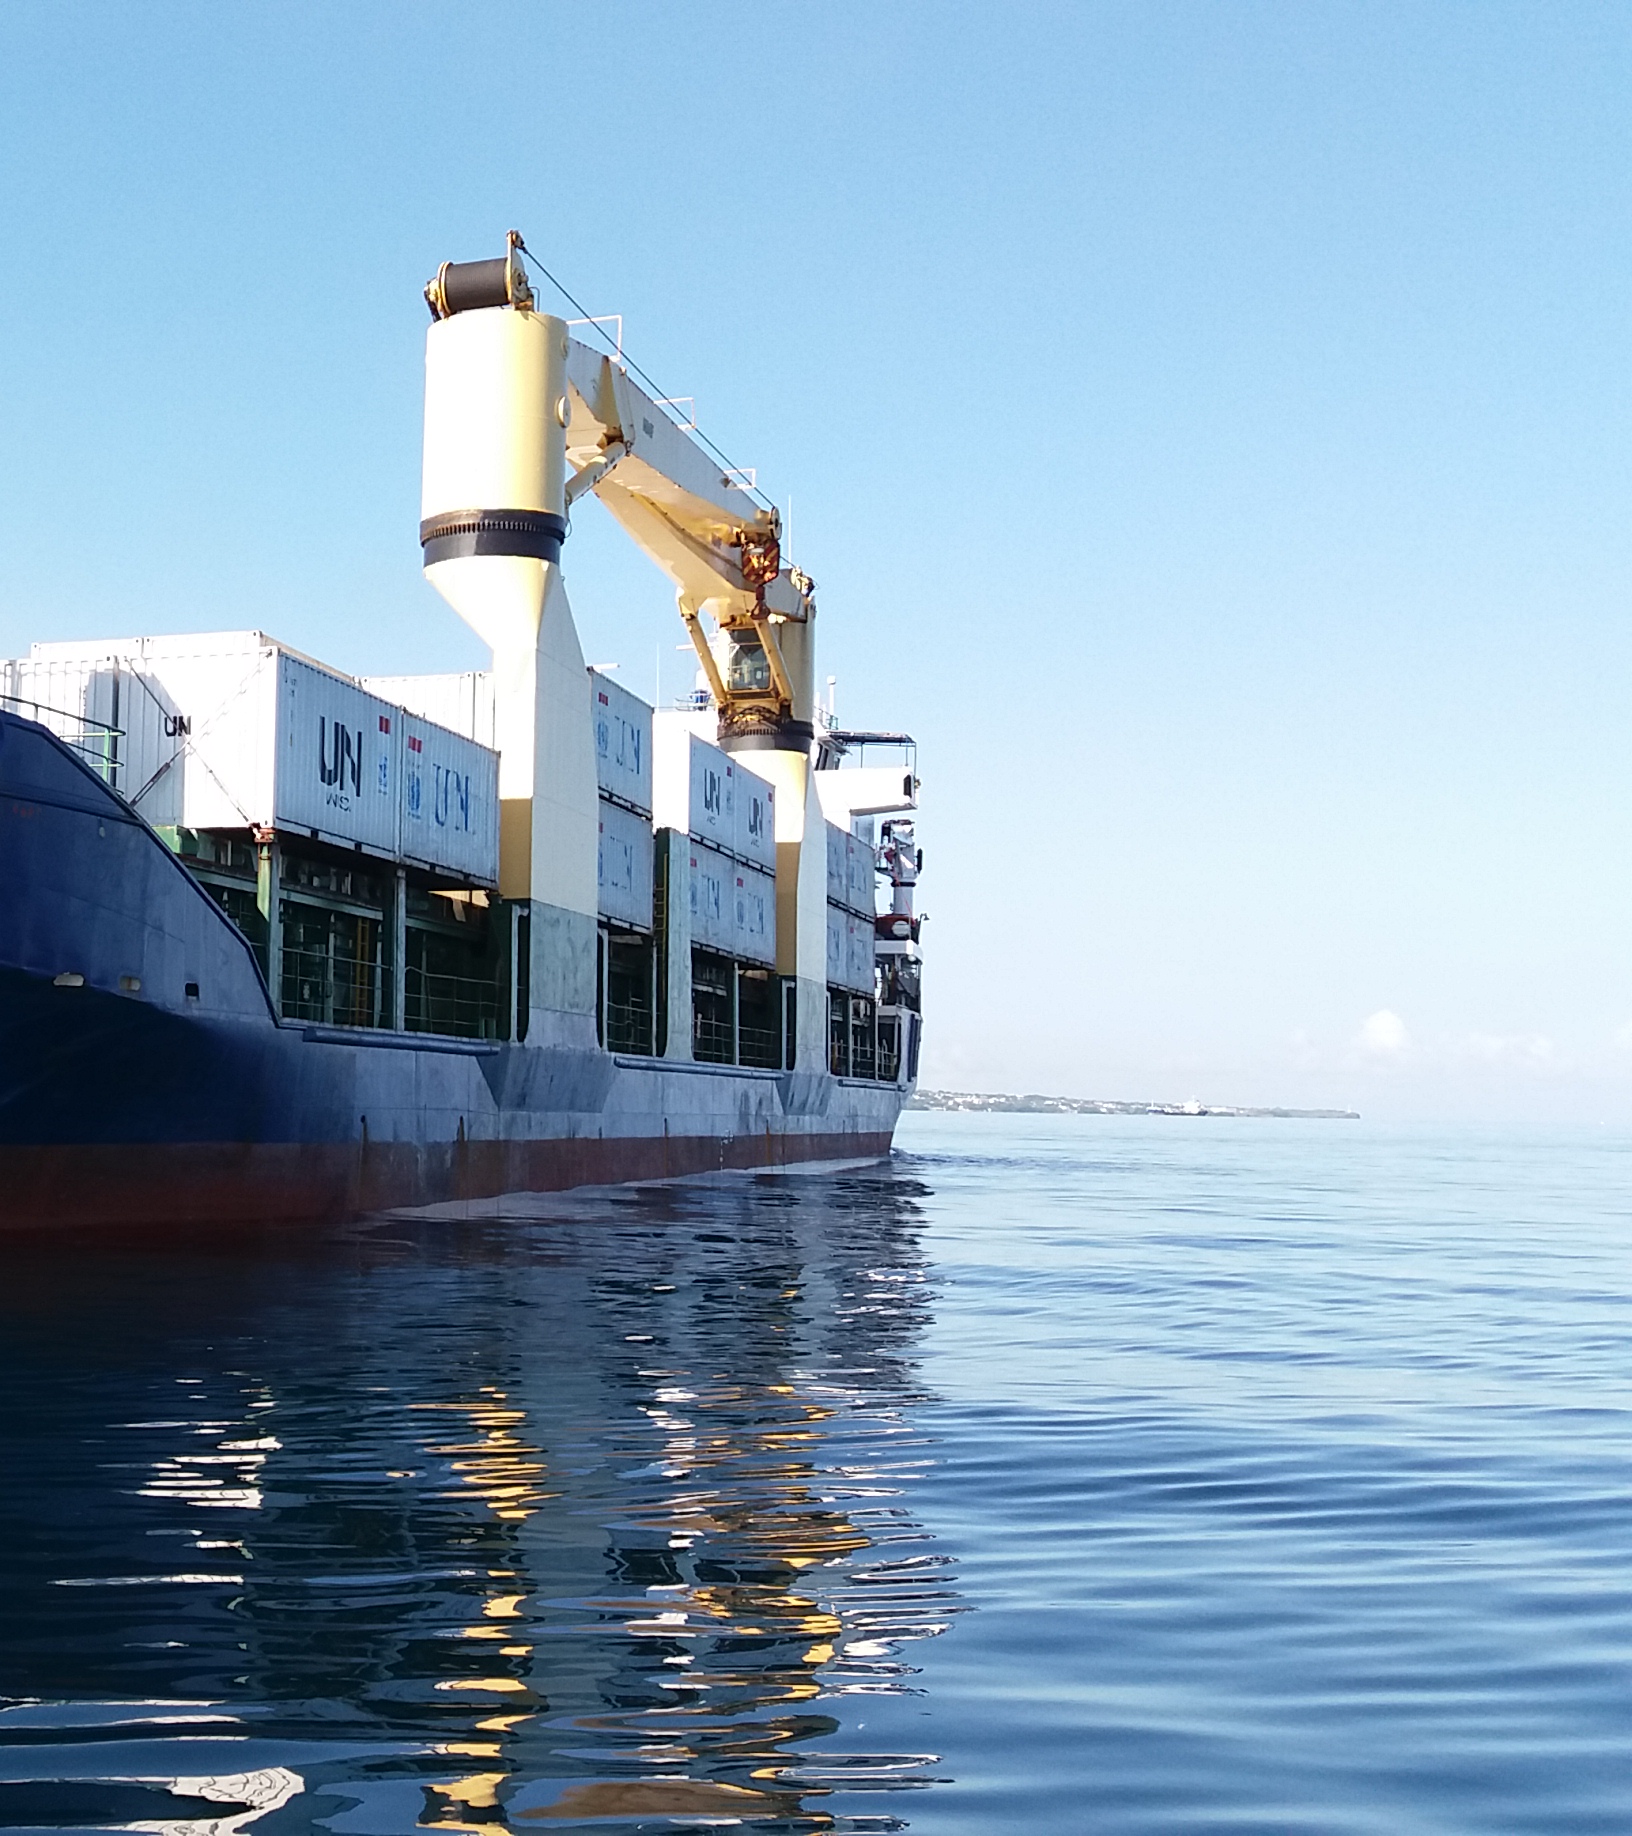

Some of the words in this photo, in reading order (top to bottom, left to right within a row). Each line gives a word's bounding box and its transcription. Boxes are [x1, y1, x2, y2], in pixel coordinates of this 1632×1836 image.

[163, 715, 192, 737] UN
[319, 715, 363, 798] UN
[432, 763, 476, 835] UN
